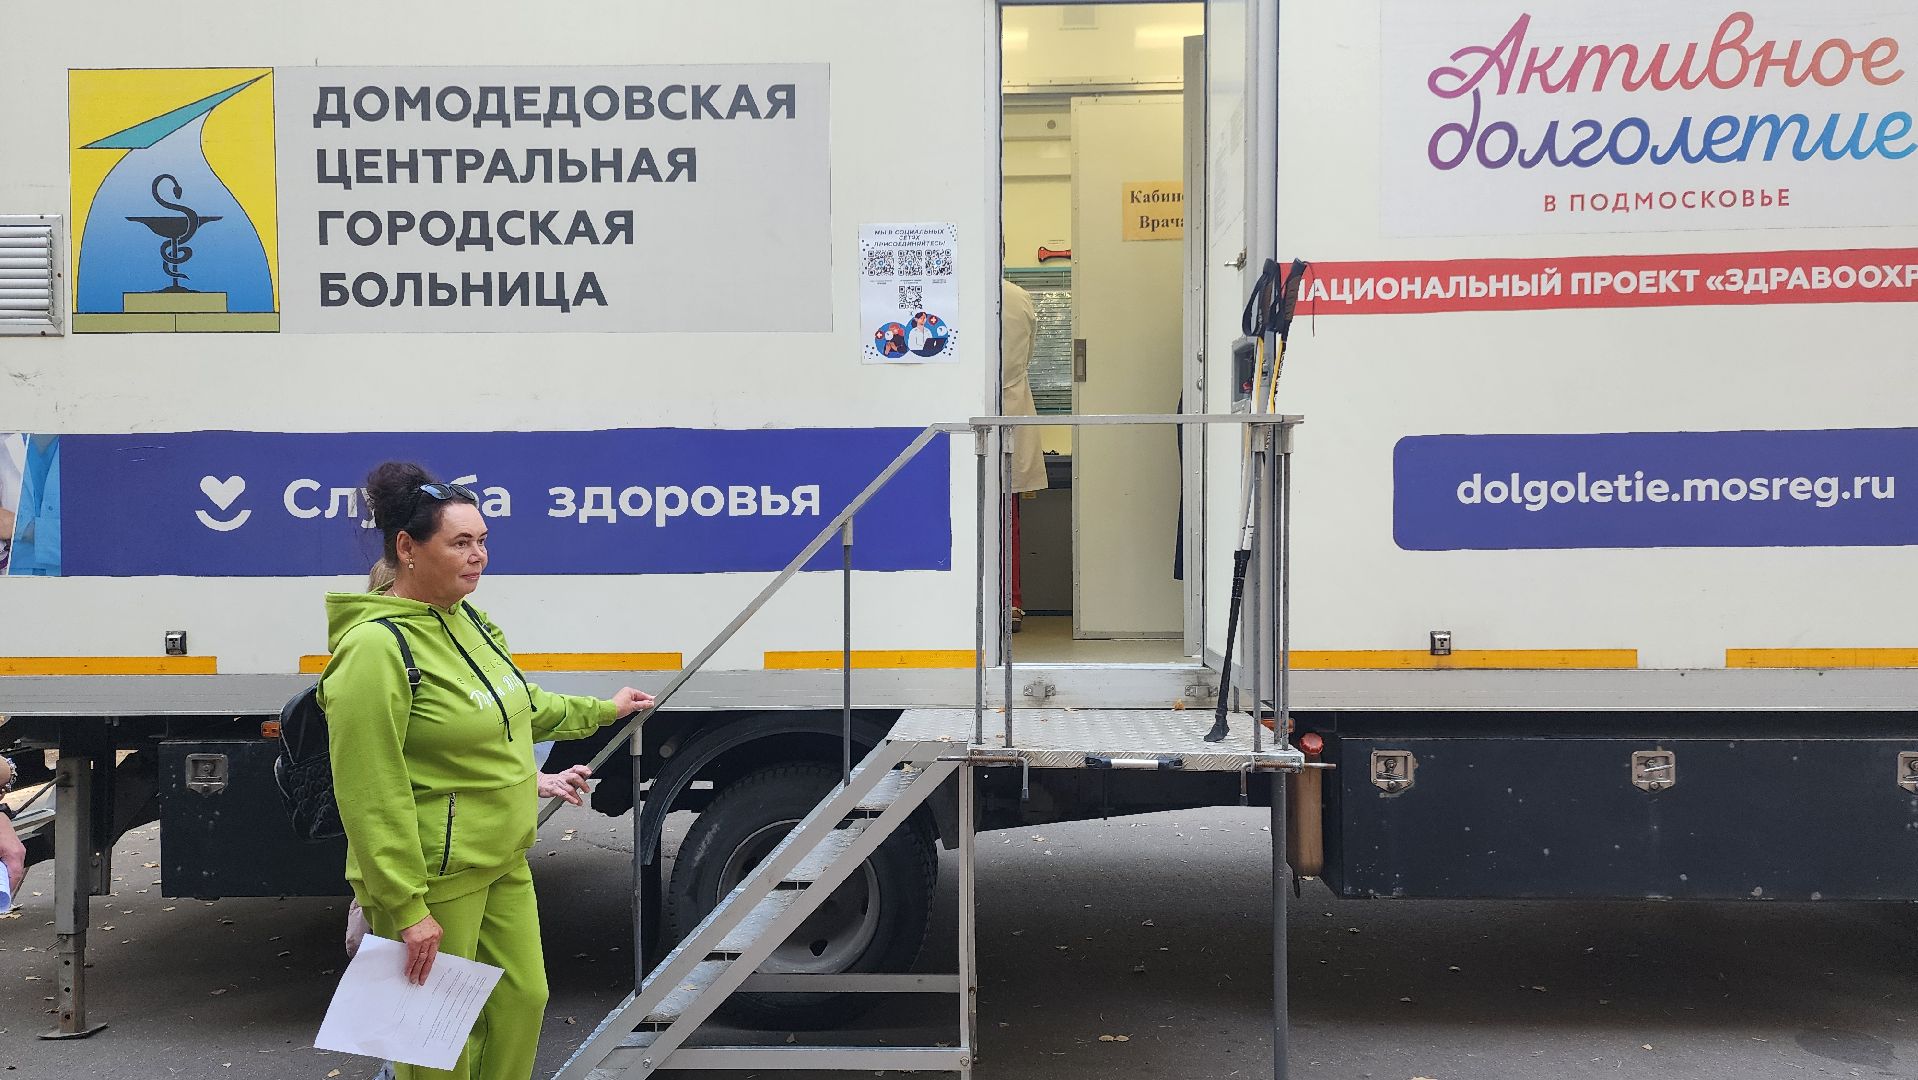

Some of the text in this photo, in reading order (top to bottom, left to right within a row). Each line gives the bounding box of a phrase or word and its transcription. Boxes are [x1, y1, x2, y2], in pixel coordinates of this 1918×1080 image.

[1427, 11, 1905, 99] Активное
[313, 84, 796, 129] ДОМОДЕДОВСКАЯ
[1427, 89, 1918, 170] долголетие
[316, 147, 697, 190] ЦЕНТРАЛЬНАЯ
[1130, 189, 1184, 204] Кабин
[1544, 188, 1791, 213] В ПОДМОСКОВЬЕ
[318, 209, 634, 252] ГОРОДСКАЯ
[895, 228, 944, 236] СОЦИАЛЬНЫХ
[320, 271, 609, 314] БОЛЬНИЦА
[1570, 269, 1701, 295] ПРОЕКТ
[547, 484, 821, 528] здоровья
[1456, 470, 1896, 512] dolgoletie.mosreg.ru
